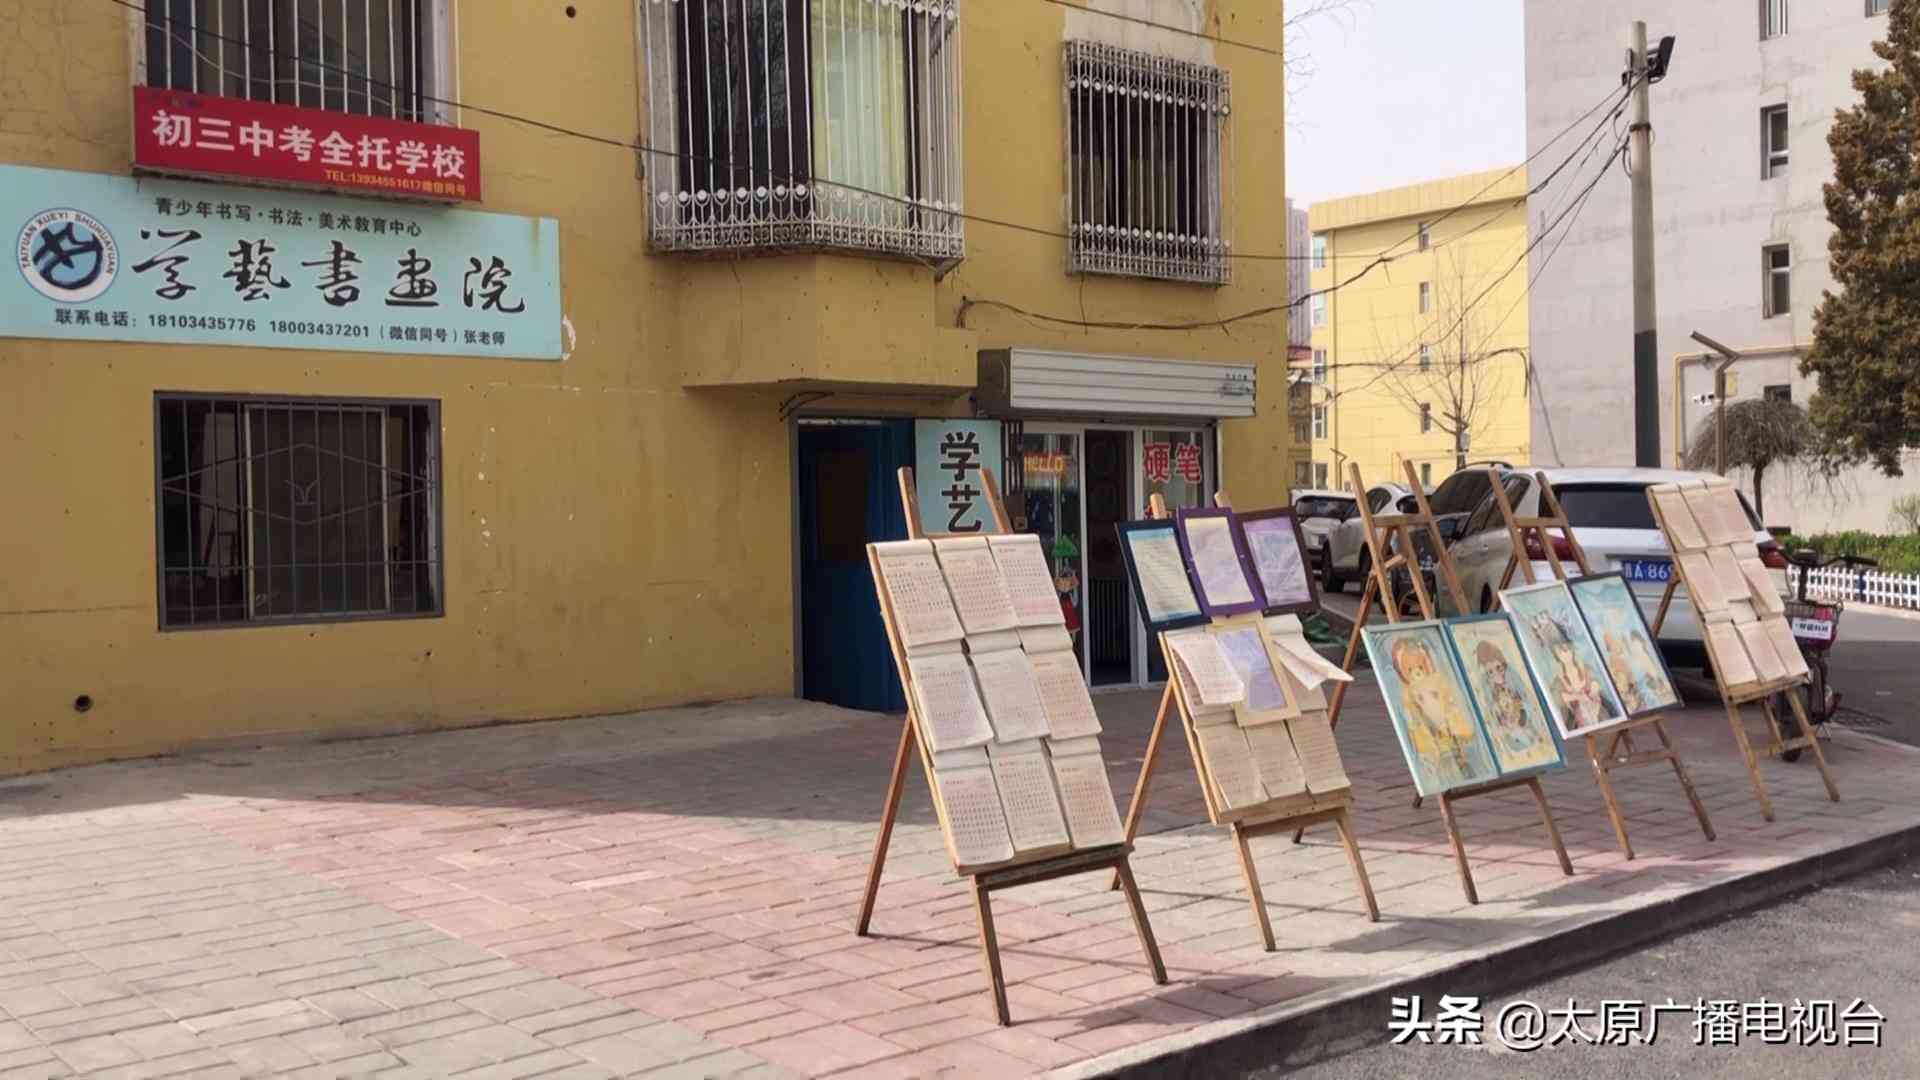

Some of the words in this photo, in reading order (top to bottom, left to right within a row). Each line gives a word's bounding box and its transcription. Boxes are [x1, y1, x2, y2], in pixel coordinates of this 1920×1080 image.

[152, 109, 465, 179] 初三中考全托学校
[20, 224, 38, 268] TAIYUAN
[36, 211, 69, 225] XUEYI
[156, 197, 423, 237] 青少年书写·书法·美术教育中心
[148, 313, 257, 333] 18103435776
[269, 319, 370, 338] 18003437201
[940, 431, 982, 532] 学艺
[1142, 441, 1201, 484] 硬笔
